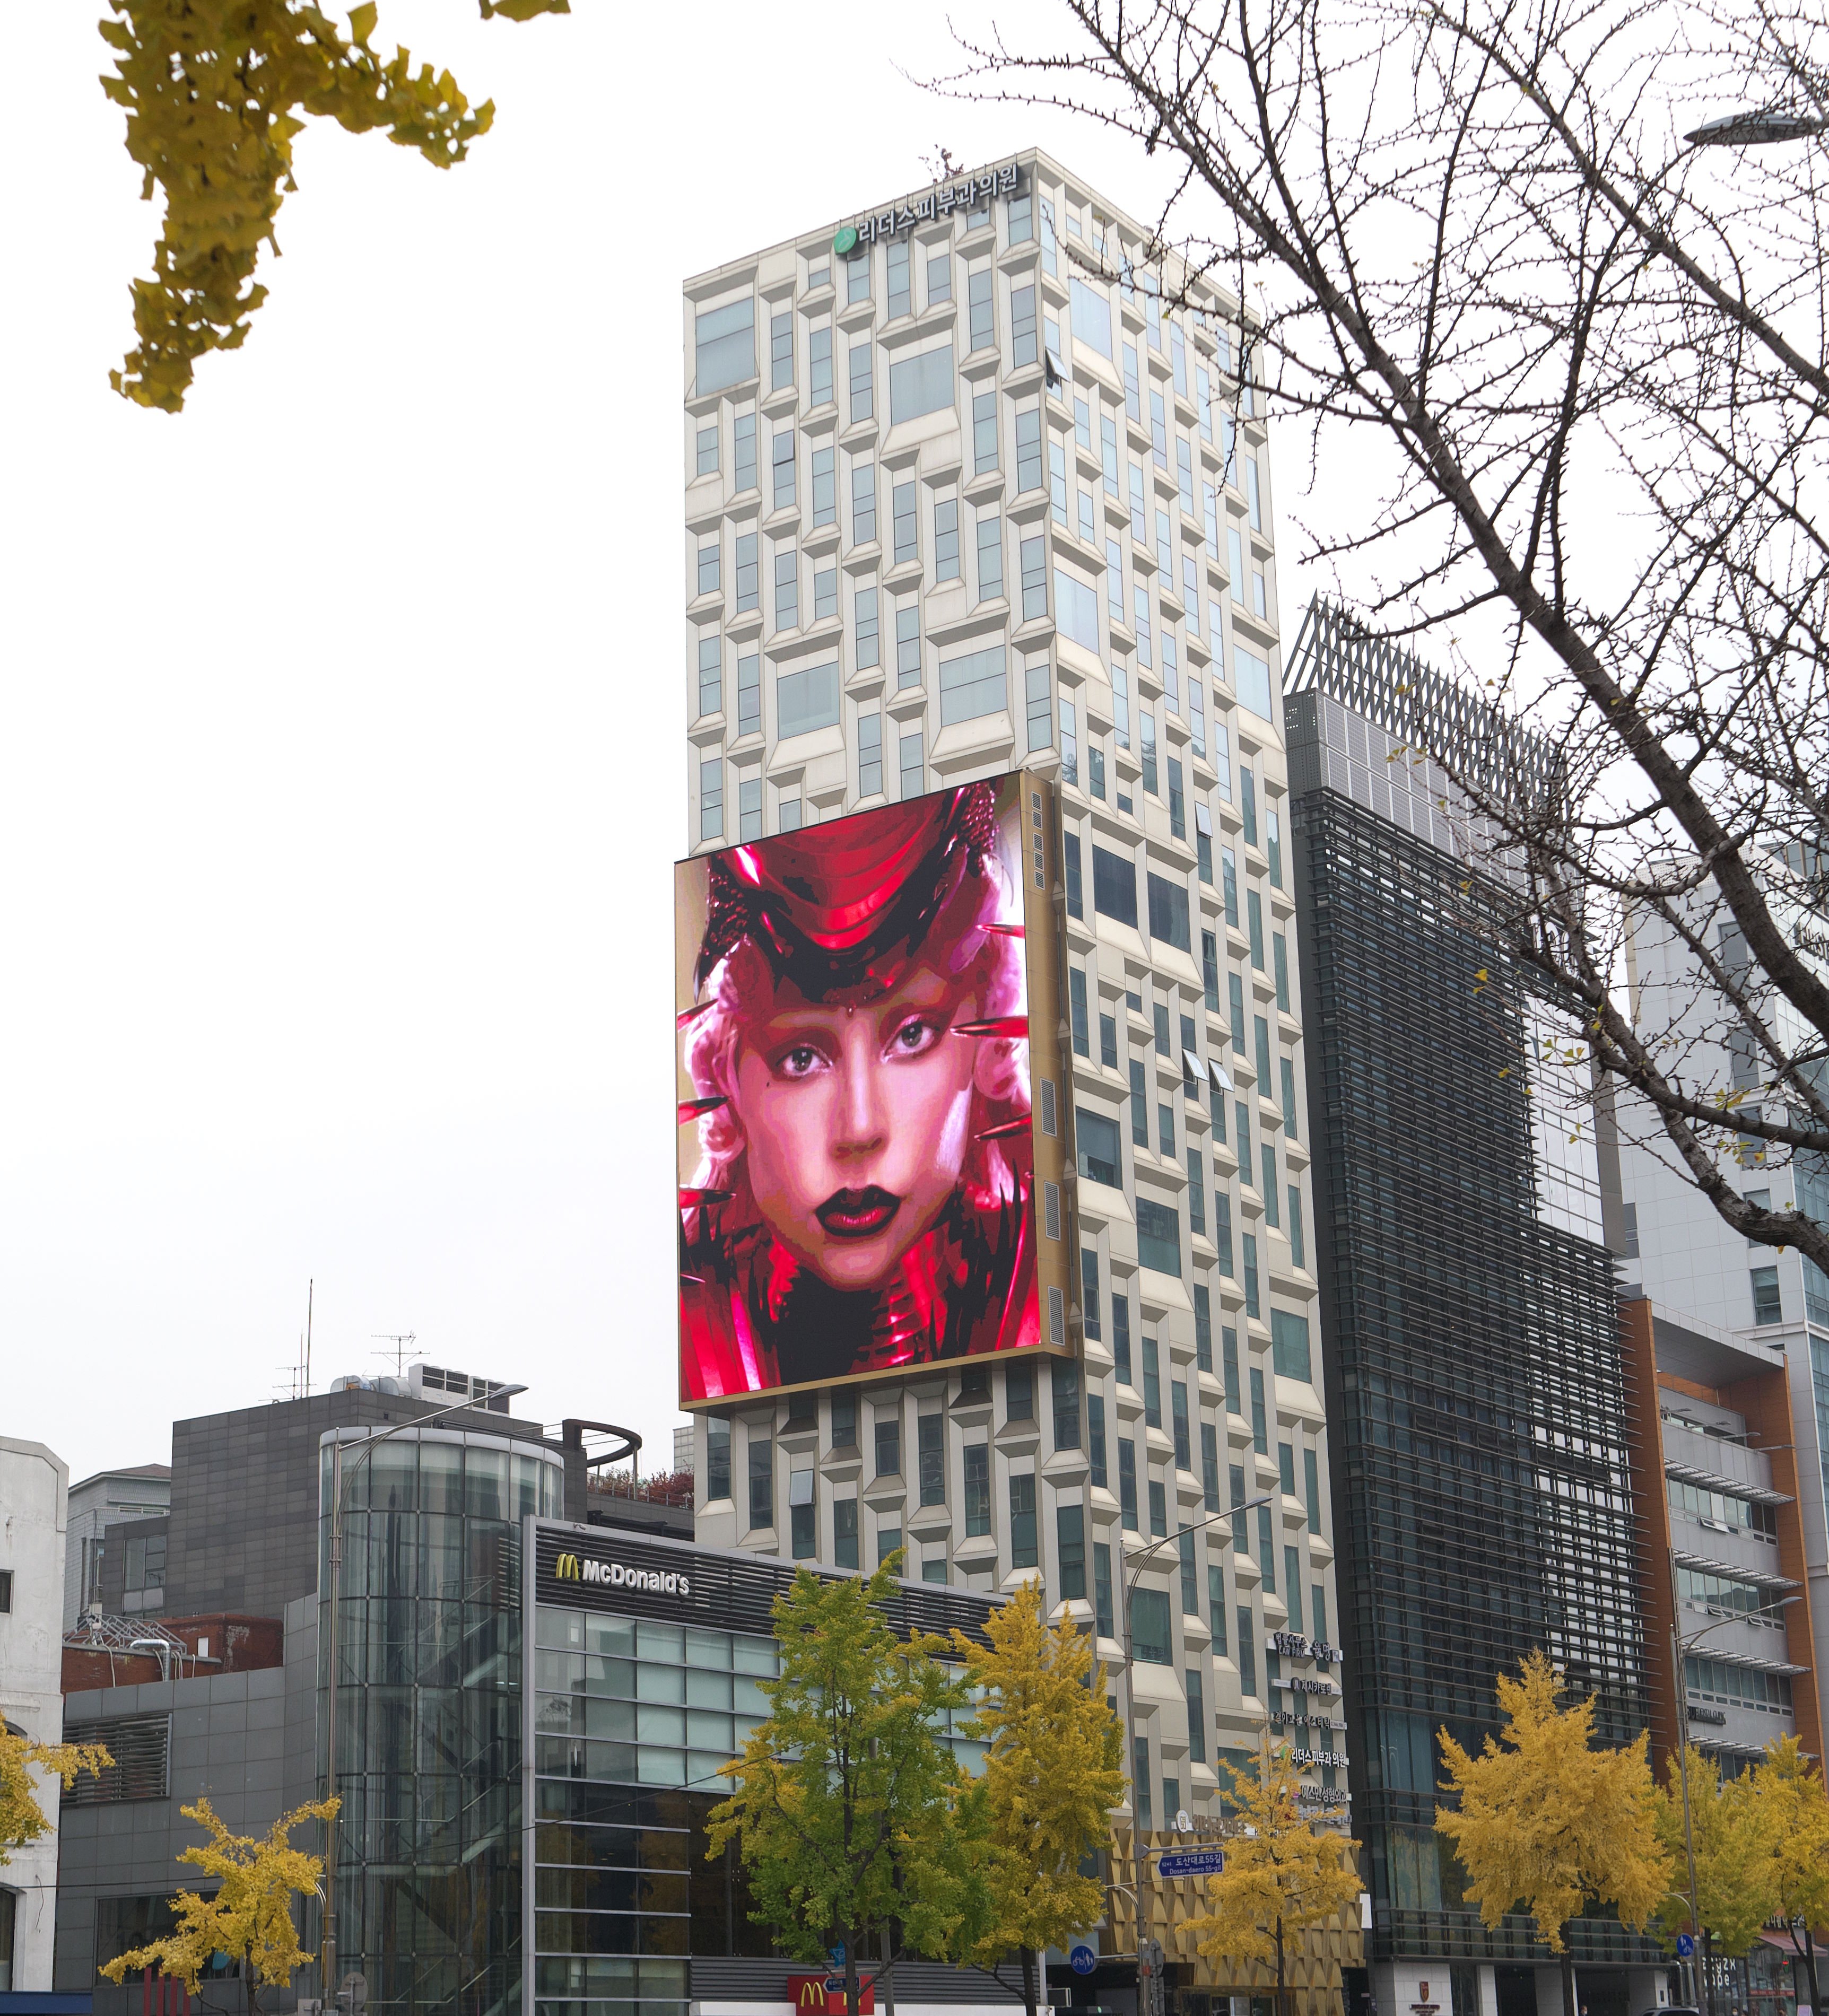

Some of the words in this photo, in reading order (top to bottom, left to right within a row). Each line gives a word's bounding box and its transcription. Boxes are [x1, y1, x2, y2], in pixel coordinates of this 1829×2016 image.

[859, 164, 1017, 242] 리더스피부과의원
[582, 1559, 690, 1596] McDonald's
[1278, 1645, 1291, 1655] LAW
[1291, 1747, 1331, 1767] 리더스피부과
[1332, 1752, 1346, 1768] 의원
[1175, 1854, 1221, 1866] 도산대로55길
[1169, 1866, 1205, 1875] Dosan-daero
[1205, 1864, 1222, 1873] 55-gil
